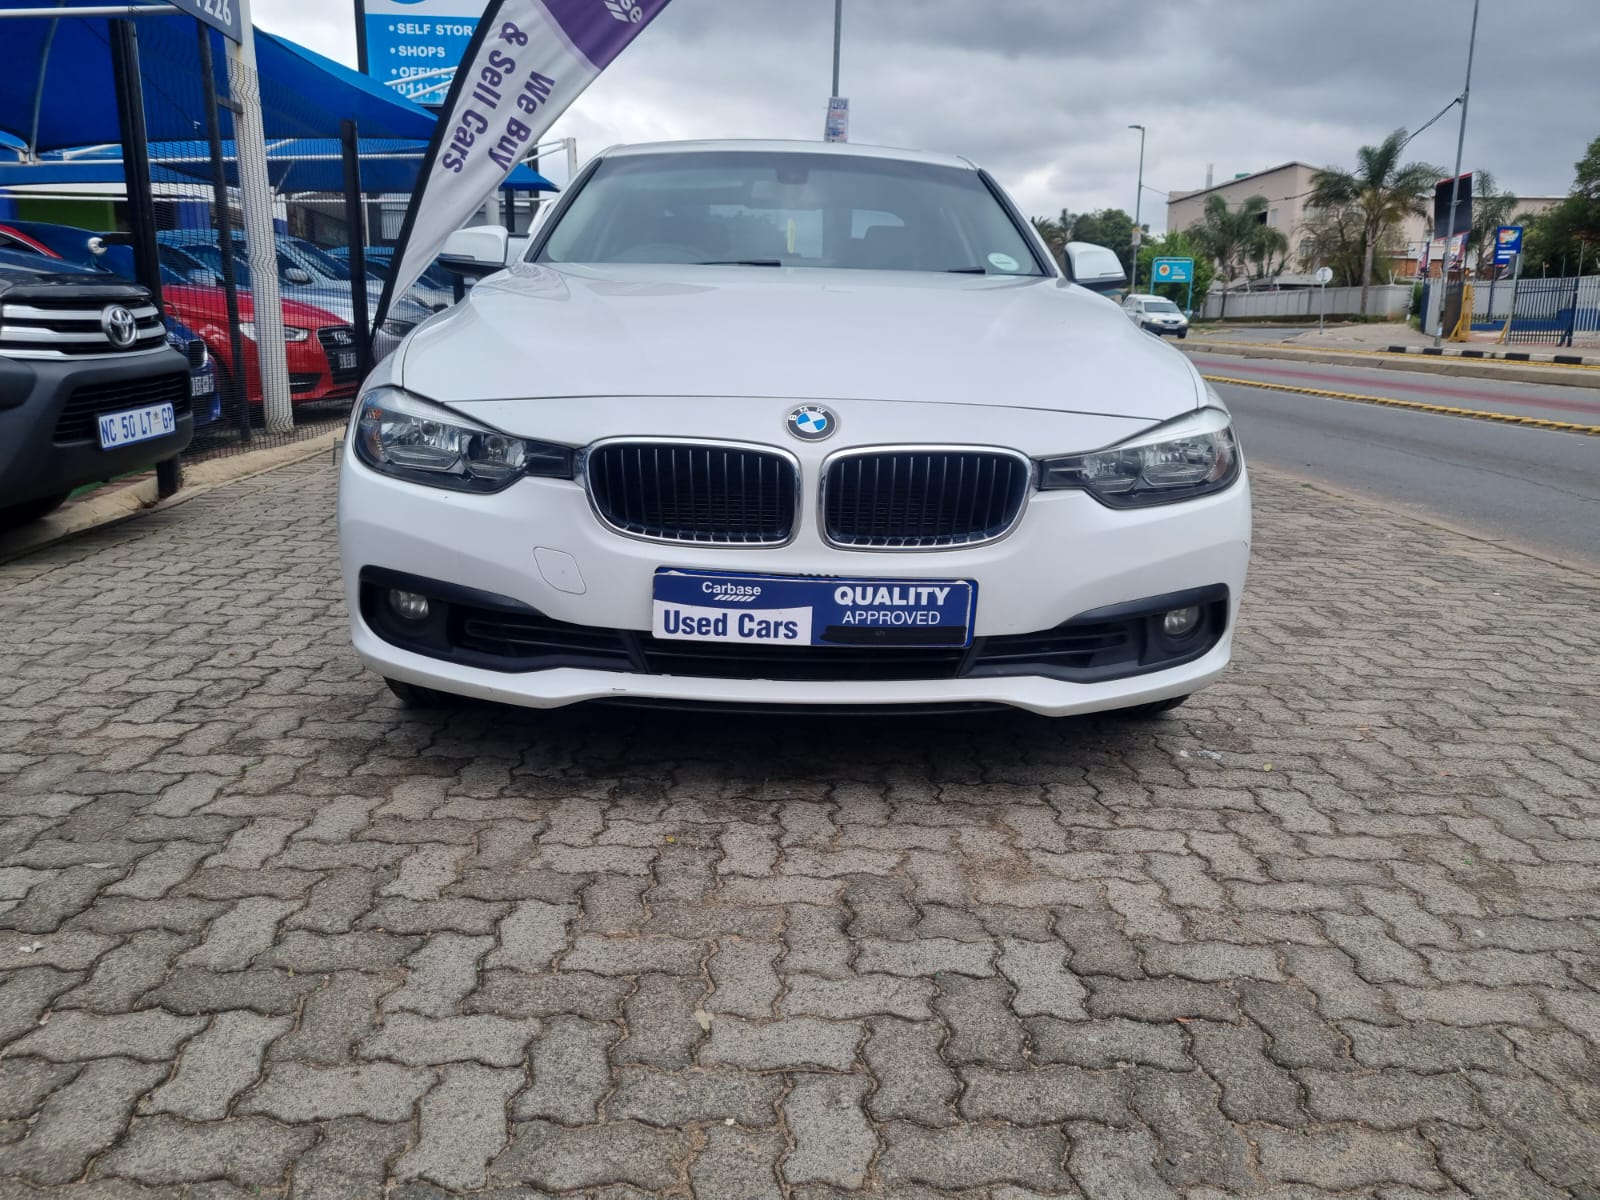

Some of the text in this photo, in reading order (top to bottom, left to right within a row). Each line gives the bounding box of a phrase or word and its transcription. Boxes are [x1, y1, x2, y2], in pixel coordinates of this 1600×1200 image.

[397, 23, 476, 36] SELF STOR
[398, 46, 445, 58] SHOPS
[442, 22, 528, 173] & Sell Cars
[488, 70, 555, 171] We Buy
[101, 406, 173, 444] NC 50 LT GP
[702, 581, 762, 597] Carbase
[834, 586, 951, 607] QUALITY
[664, 609, 799, 640] Used Cars
[842, 611, 941, 625] APPROVED
